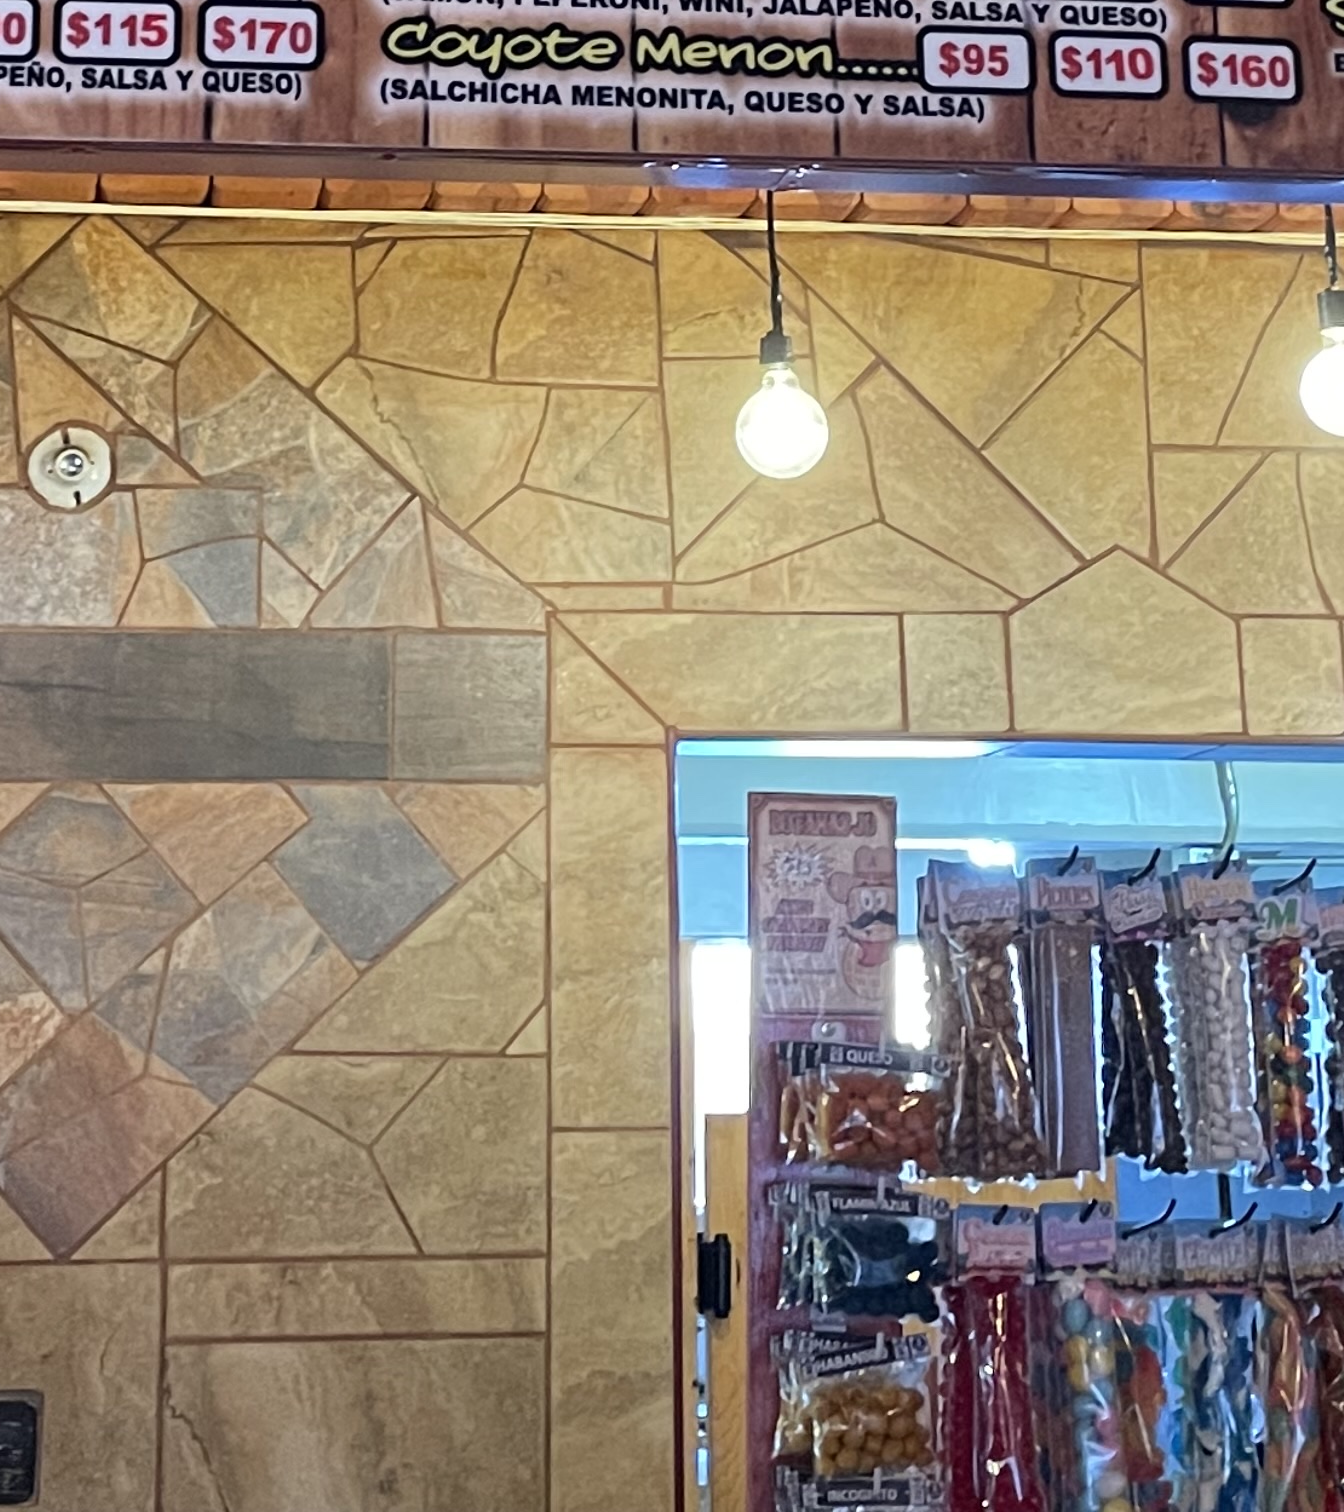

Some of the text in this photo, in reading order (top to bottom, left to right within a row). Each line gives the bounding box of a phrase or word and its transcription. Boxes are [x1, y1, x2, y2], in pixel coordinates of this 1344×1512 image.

[68, 13, 168, 47] $115
[215, 17, 312, 54] $170
[386, 20, 618, 75] Coyote
[940, 43, 1007, 76] $95
[1062, 47, 1154, 80] $110
[1199, 53, 1289, 87] $160
[380, 78, 985, 124] (SALCHICHA MENONITA, QUESO Y SALSA)
